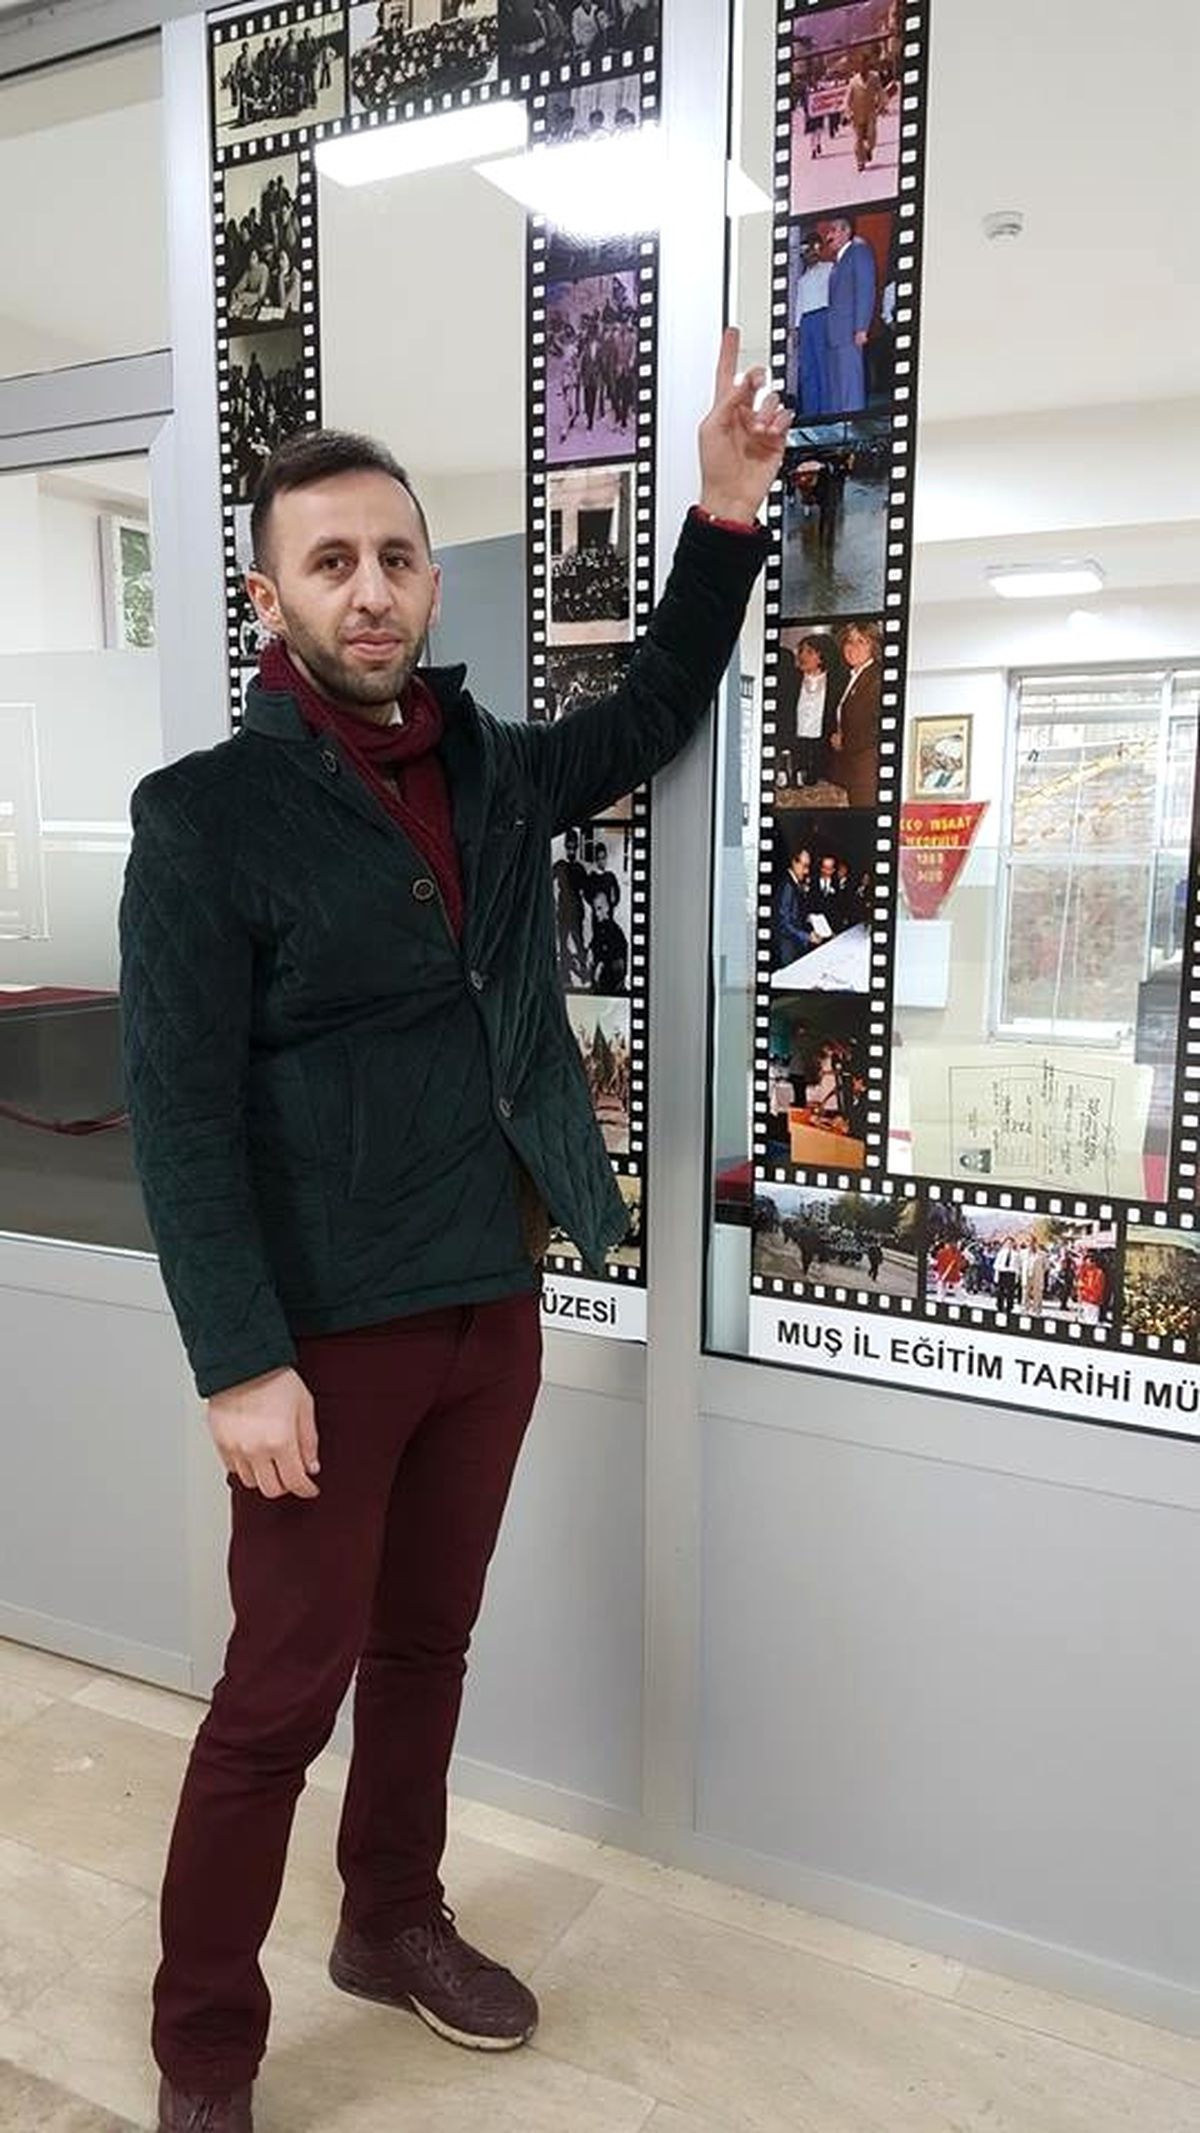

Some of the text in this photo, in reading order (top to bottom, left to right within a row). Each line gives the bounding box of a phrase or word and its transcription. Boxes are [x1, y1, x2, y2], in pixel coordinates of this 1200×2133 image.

[777, 1319, 1200, 1413] MUŞ İL EĞİTİM TARİHİ MÜ
